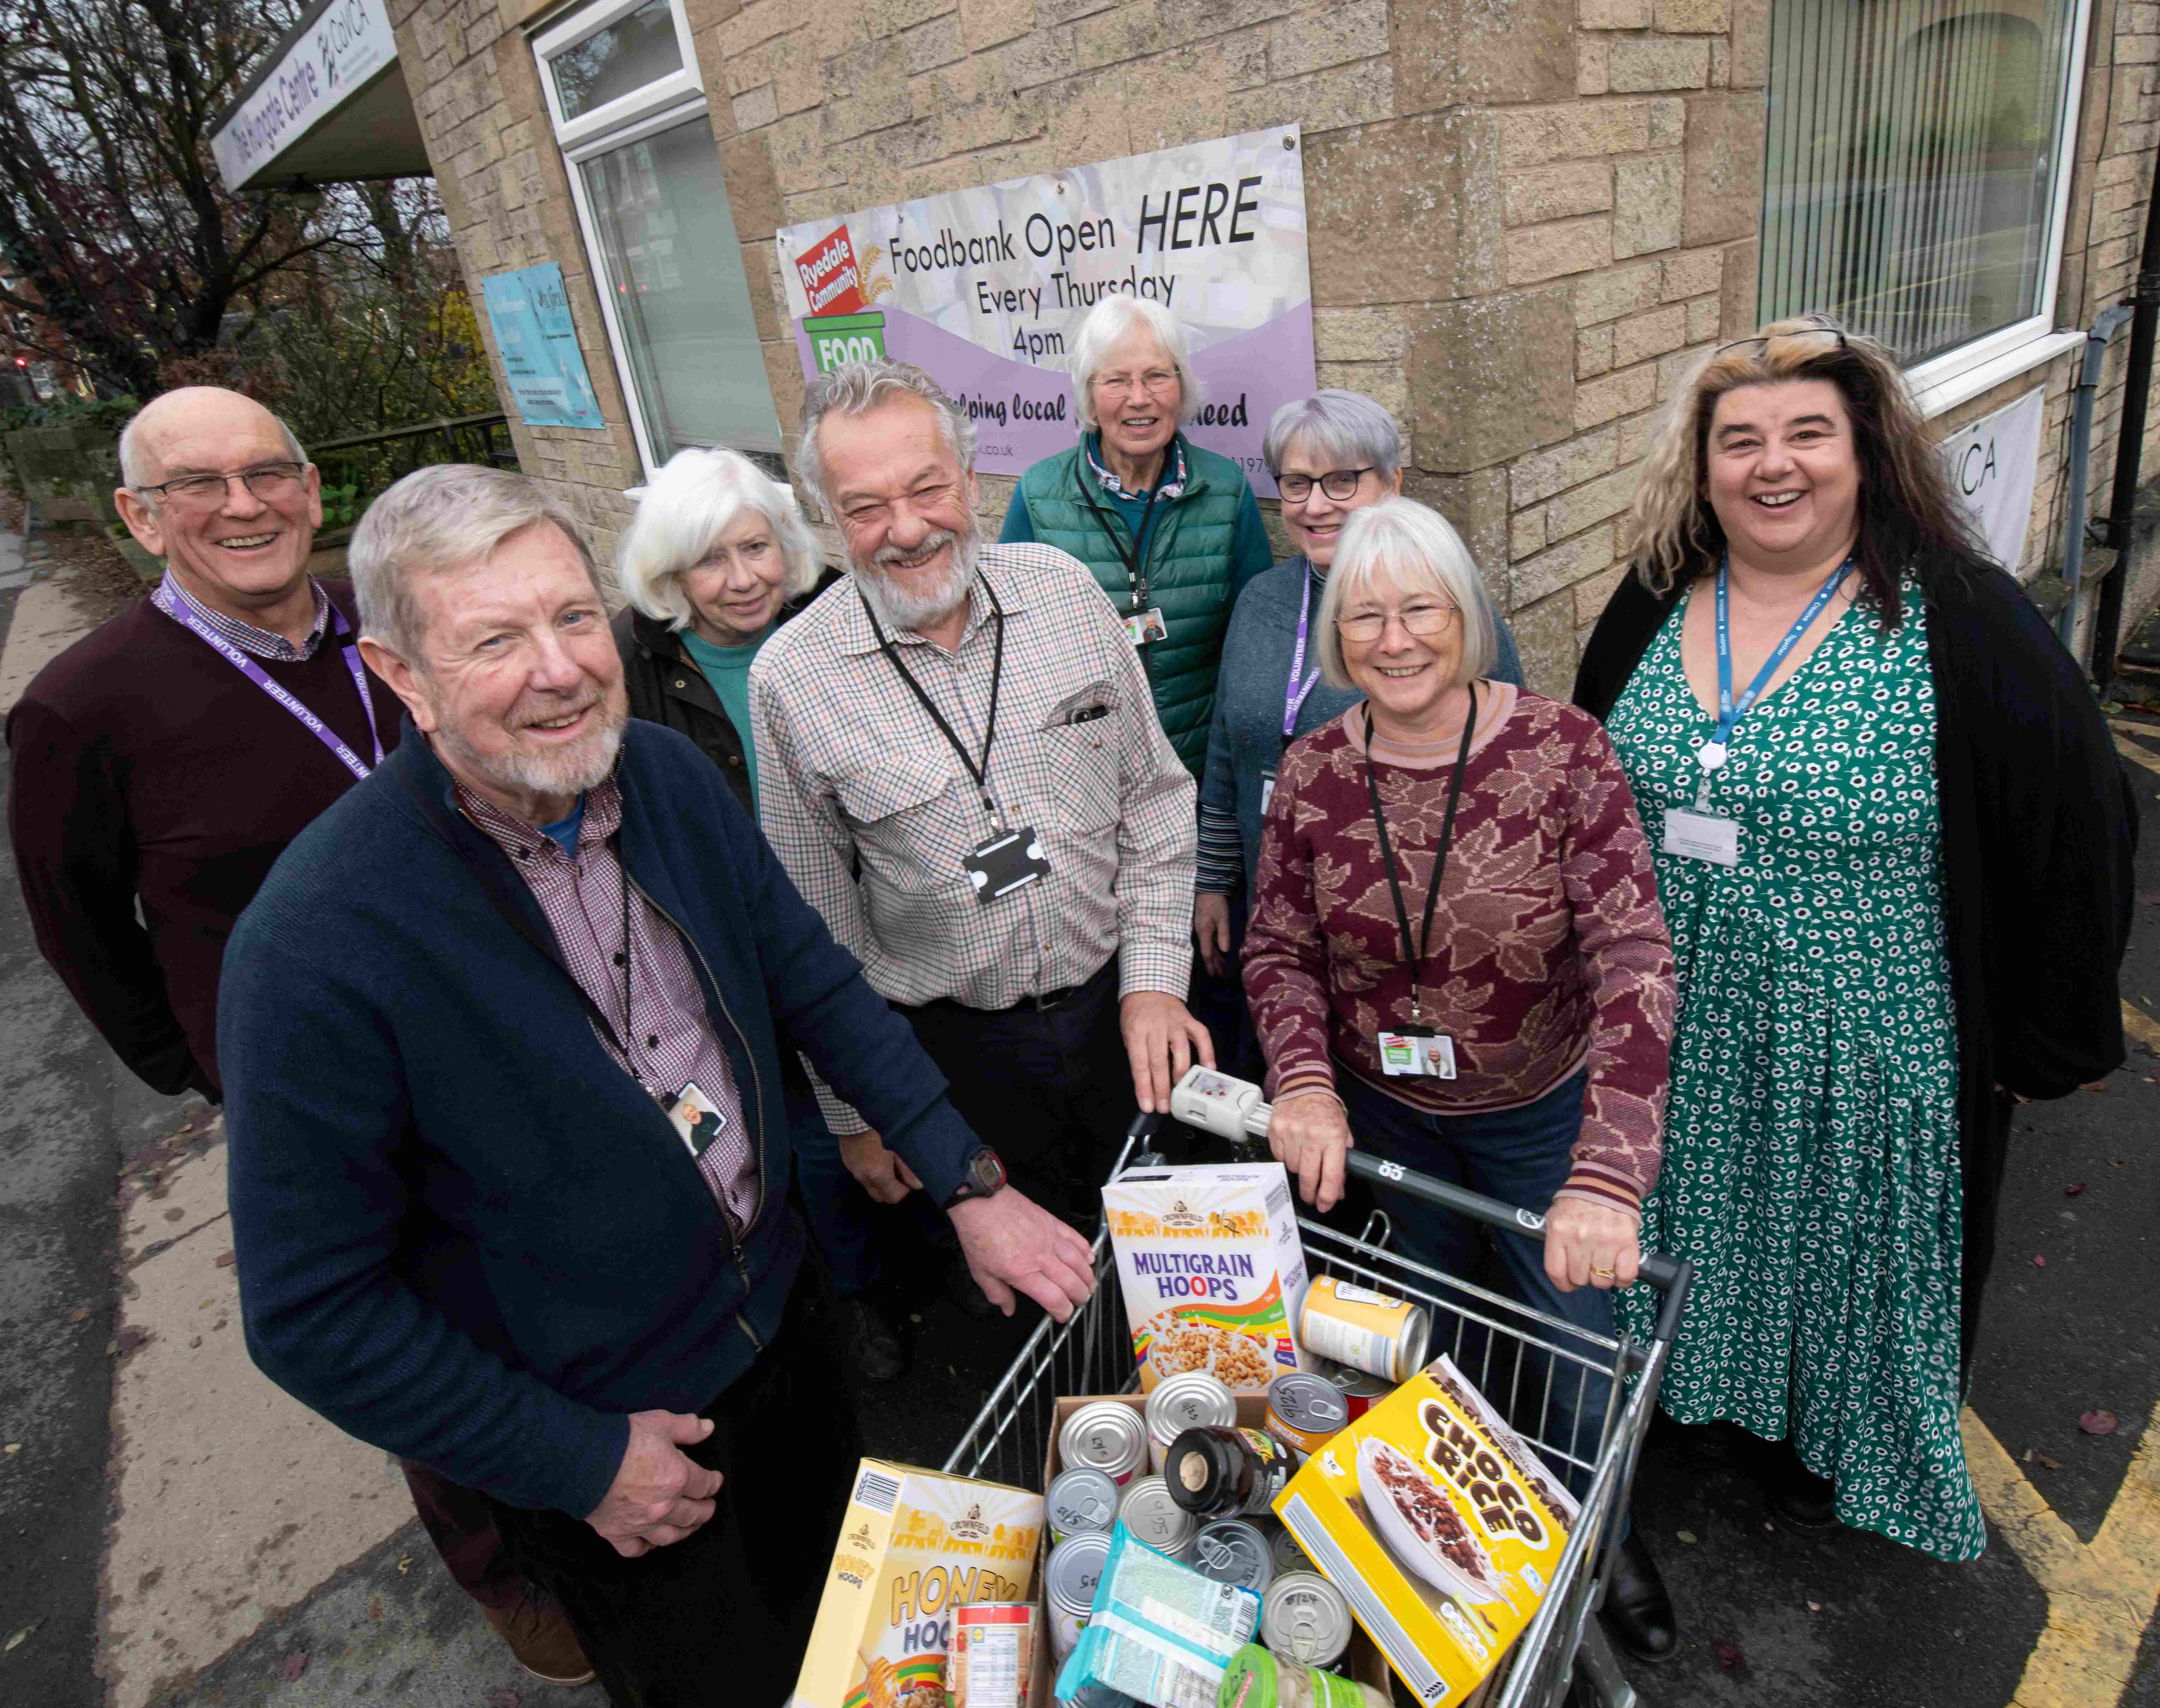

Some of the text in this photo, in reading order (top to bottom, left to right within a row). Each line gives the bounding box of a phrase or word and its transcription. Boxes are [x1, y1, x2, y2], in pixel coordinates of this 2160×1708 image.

[890, 176, 1263, 274] Foodbank Open HERE
[799, 237, 850, 288] Ryedale
[808, 265, 859, 313] Community
[977, 265, 1175, 320] Every Thursday
[818, 336, 878, 372] FOOD
[1013, 326, 1065, 364] 4pm
[954, 393, 1006, 427] lping
[1012, 393, 1066, 421] local
[1802, 601, 1821, 623] Creative
[186, 614, 249, 668] VOLUNTEER
[1290, 637, 1305, 683] VOLUNTEER
[1778, 634, 1797, 656] Together
[263, 679, 324, 732] VOLUNTEER
[1131, 1252, 1255, 1278] MULTIGRAIN
[1156, 1275, 1239, 1301] HOOPS
[1275, 1387, 1303, 1418] 9/25
[1425, 1404, 1542, 1542] CHOCO
[891, 1565, 1018, 1628] HONEY
[903, 1620, 951, 1654] HOO
